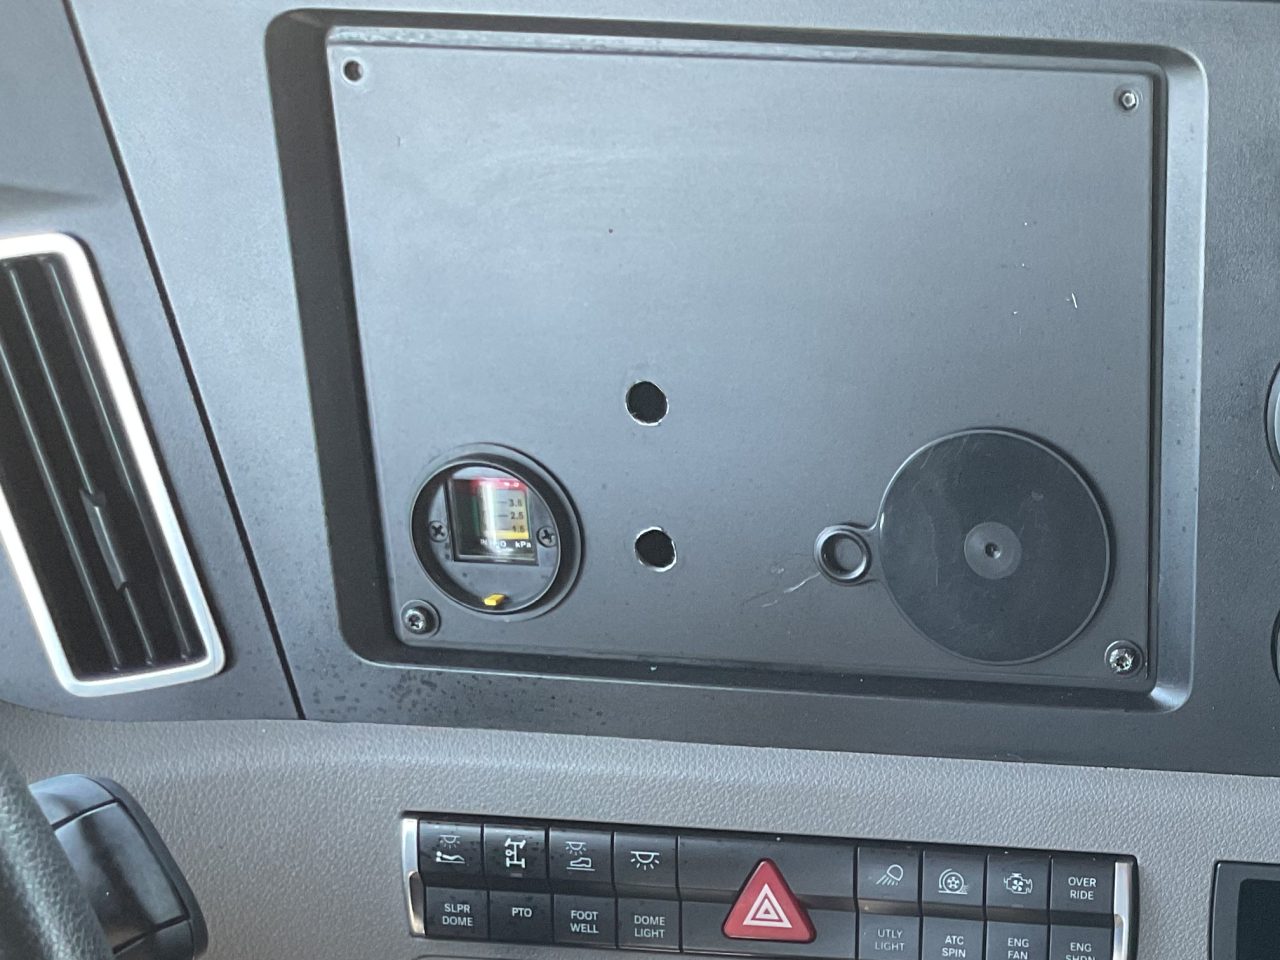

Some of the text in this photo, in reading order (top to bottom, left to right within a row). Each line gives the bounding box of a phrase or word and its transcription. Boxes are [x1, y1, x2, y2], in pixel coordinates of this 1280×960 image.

[515, 540, 532, 548] kPa
[1068, 877, 1097, 888] OVER
[1069, 890, 1095, 901] RIDE
[444, 903, 471, 914] SLPR
[511, 906, 533, 918] PTO
[442, 915, 474, 926] DOME
[570, 910, 599, 921] FOOT
[634, 915, 666, 926] DOME
[570, 922, 599, 934] WELL
[634, 928, 666, 939] LIGHT
[877, 928, 903, 939] UTLY
[945, 935, 965, 946] ATC
[1007, 937, 1030, 949] ENG
[874, 941, 905, 952] LIGHT
[1070, 941, 1092, 952] ENG
[941, 947, 967, 959] SPIN
[1008, 950, 1029, 960] FAN
